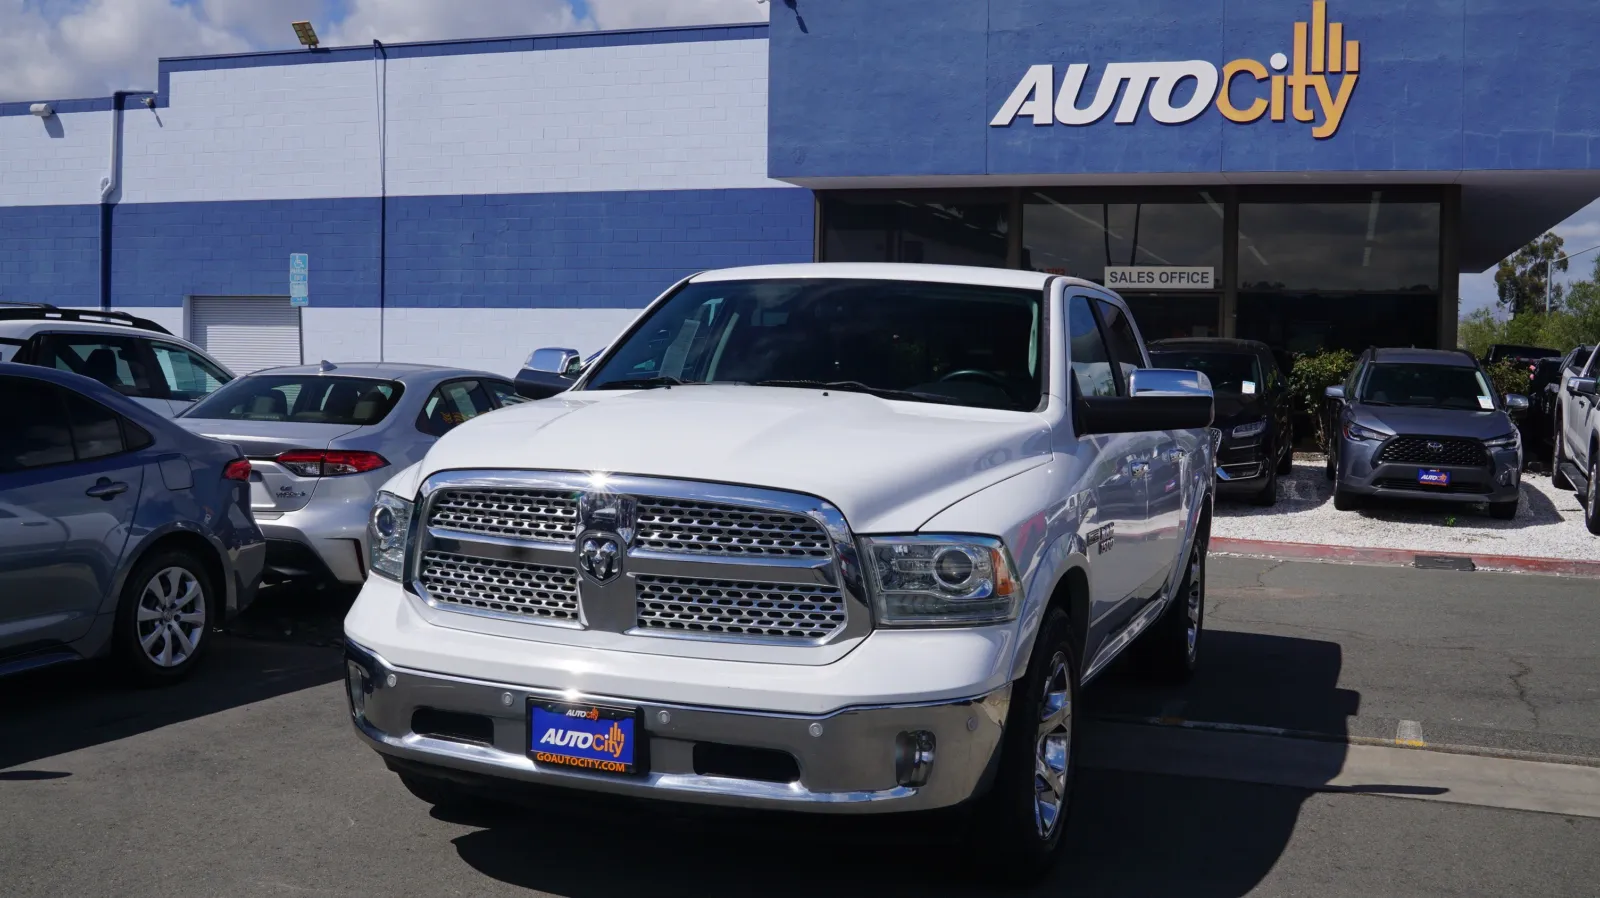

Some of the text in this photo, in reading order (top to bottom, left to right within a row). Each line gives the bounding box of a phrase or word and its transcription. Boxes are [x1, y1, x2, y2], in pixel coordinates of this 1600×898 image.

[1109, 271, 1210, 284] SALES OFFICE
[537, 752, 625, 773] GOAUTOCITY.COM
